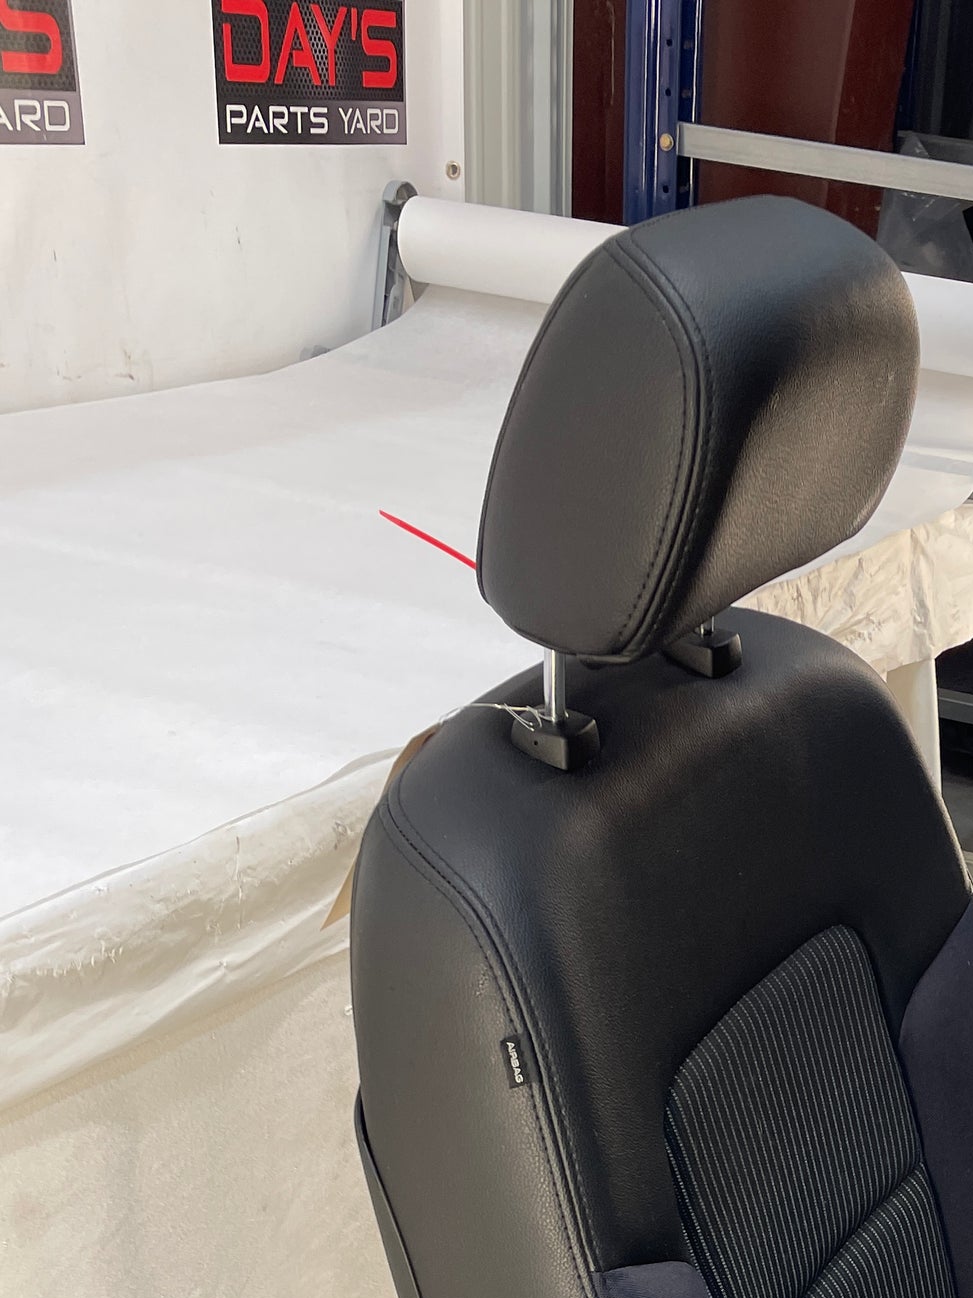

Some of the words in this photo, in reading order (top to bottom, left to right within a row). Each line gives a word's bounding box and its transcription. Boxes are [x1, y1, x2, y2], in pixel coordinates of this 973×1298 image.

[221, 0, 398, 88] DAY'S
[225, 104, 329, 135] PARTS
[338, 107, 399, 135] YARD
[506, 1041, 524, 1084] AIRBAG
